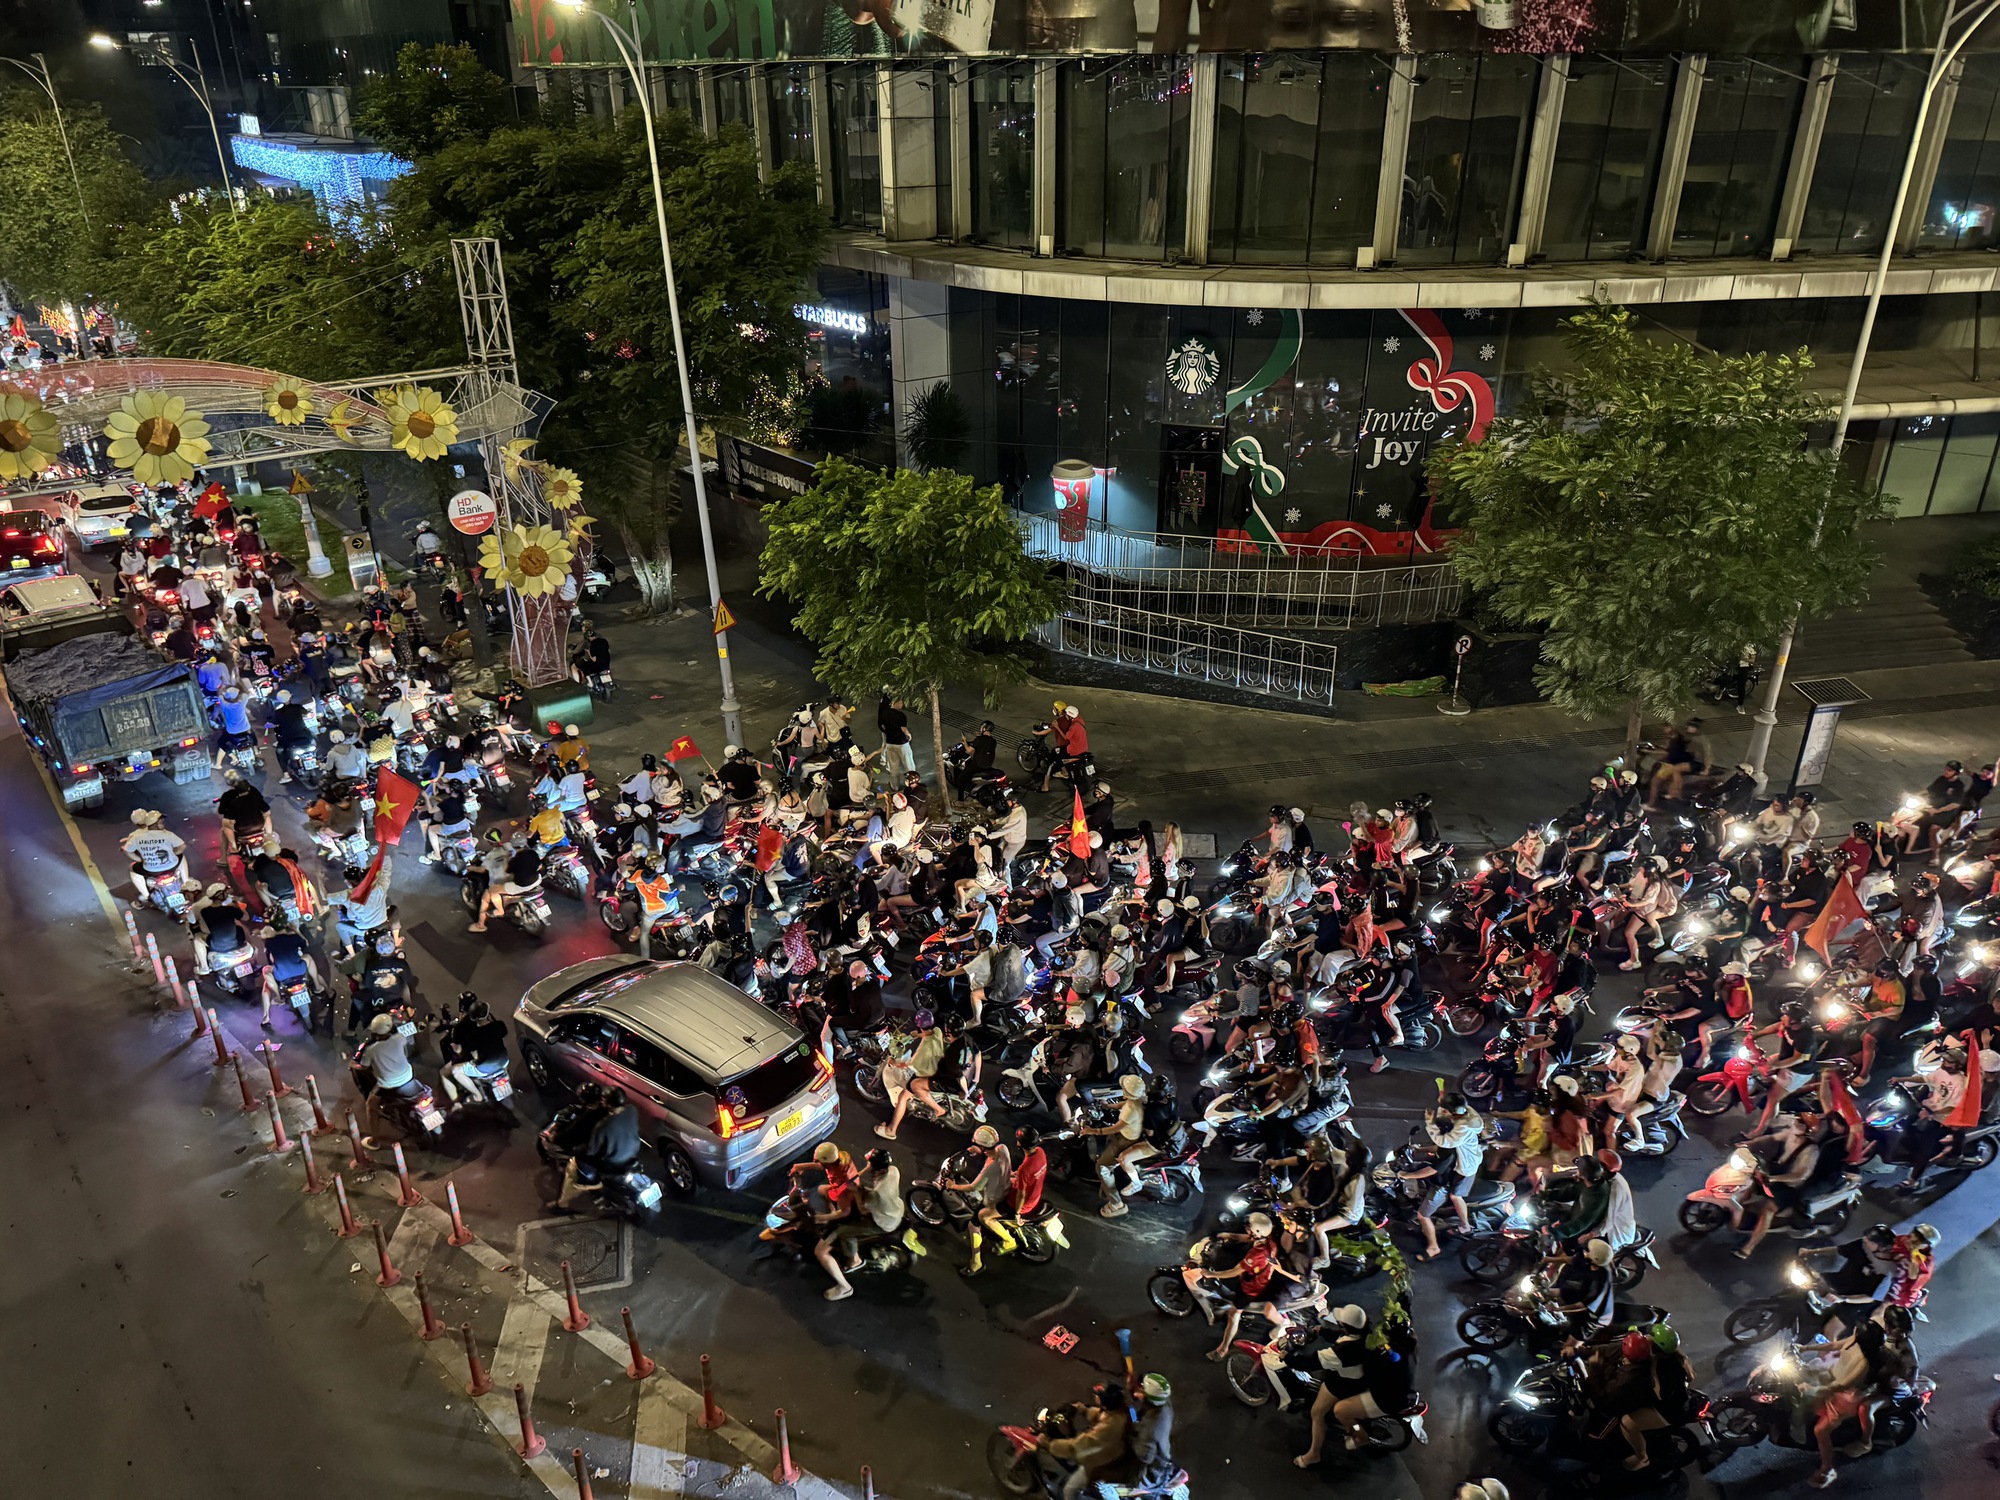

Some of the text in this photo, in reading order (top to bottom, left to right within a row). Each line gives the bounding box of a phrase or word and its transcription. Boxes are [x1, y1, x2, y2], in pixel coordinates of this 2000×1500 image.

[793, 303, 867, 334] STARBUCKS
[1361, 406, 1436, 432] Invite
[1365, 437, 1421, 469] Joy
[456, 497, 472, 508] HD
[458, 504, 484, 516] Bank
[181, 757, 207, 769] HINO
[71, 786, 99, 800] HINO
